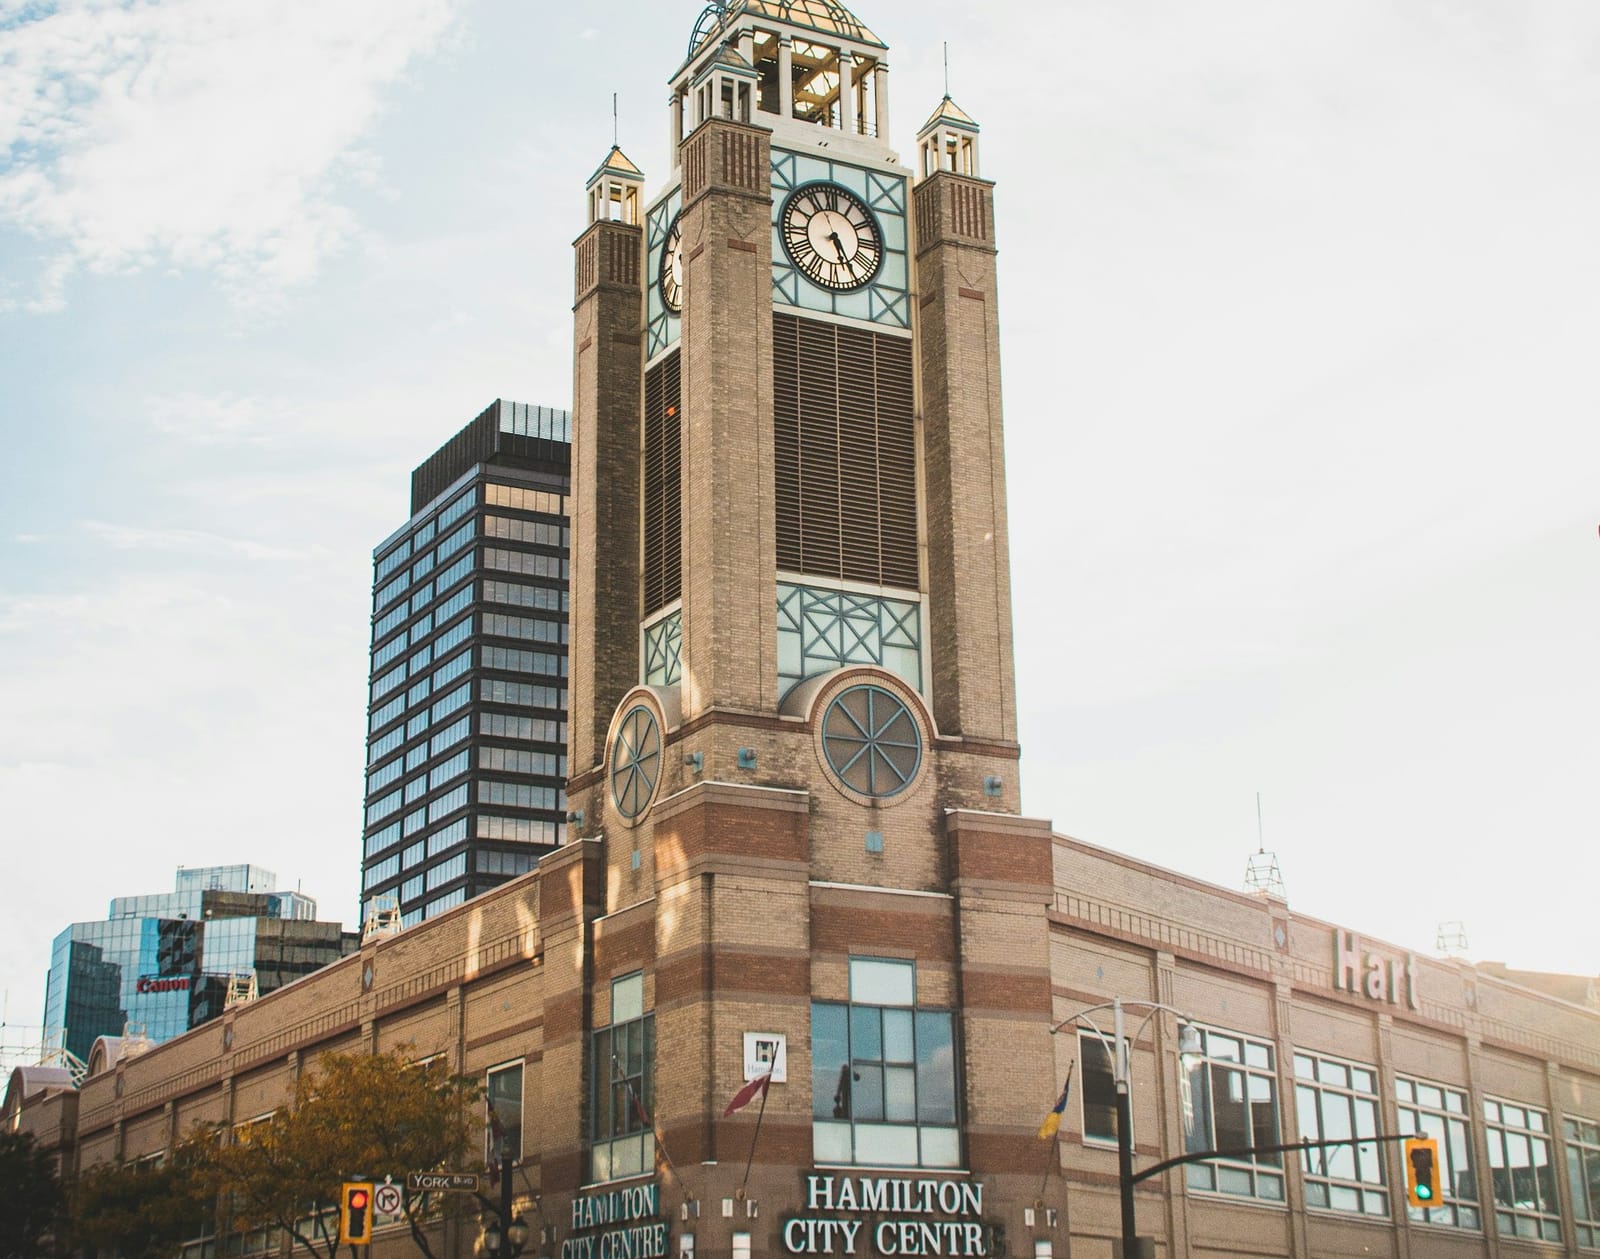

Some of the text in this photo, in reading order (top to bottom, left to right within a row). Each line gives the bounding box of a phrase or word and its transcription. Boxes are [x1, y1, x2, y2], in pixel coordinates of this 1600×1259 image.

[136, 978, 189, 993] Canon
[1333, 927, 1421, 1010] Hart
[414, 1175, 449, 1188] YORK
[807, 1176, 983, 1215] HAMILTON
[572, 1184, 656, 1230] HAMILTON
[561, 1223, 665, 1259] CITY CENTRE
[784, 1219, 1003, 1258] CITY CENTR
